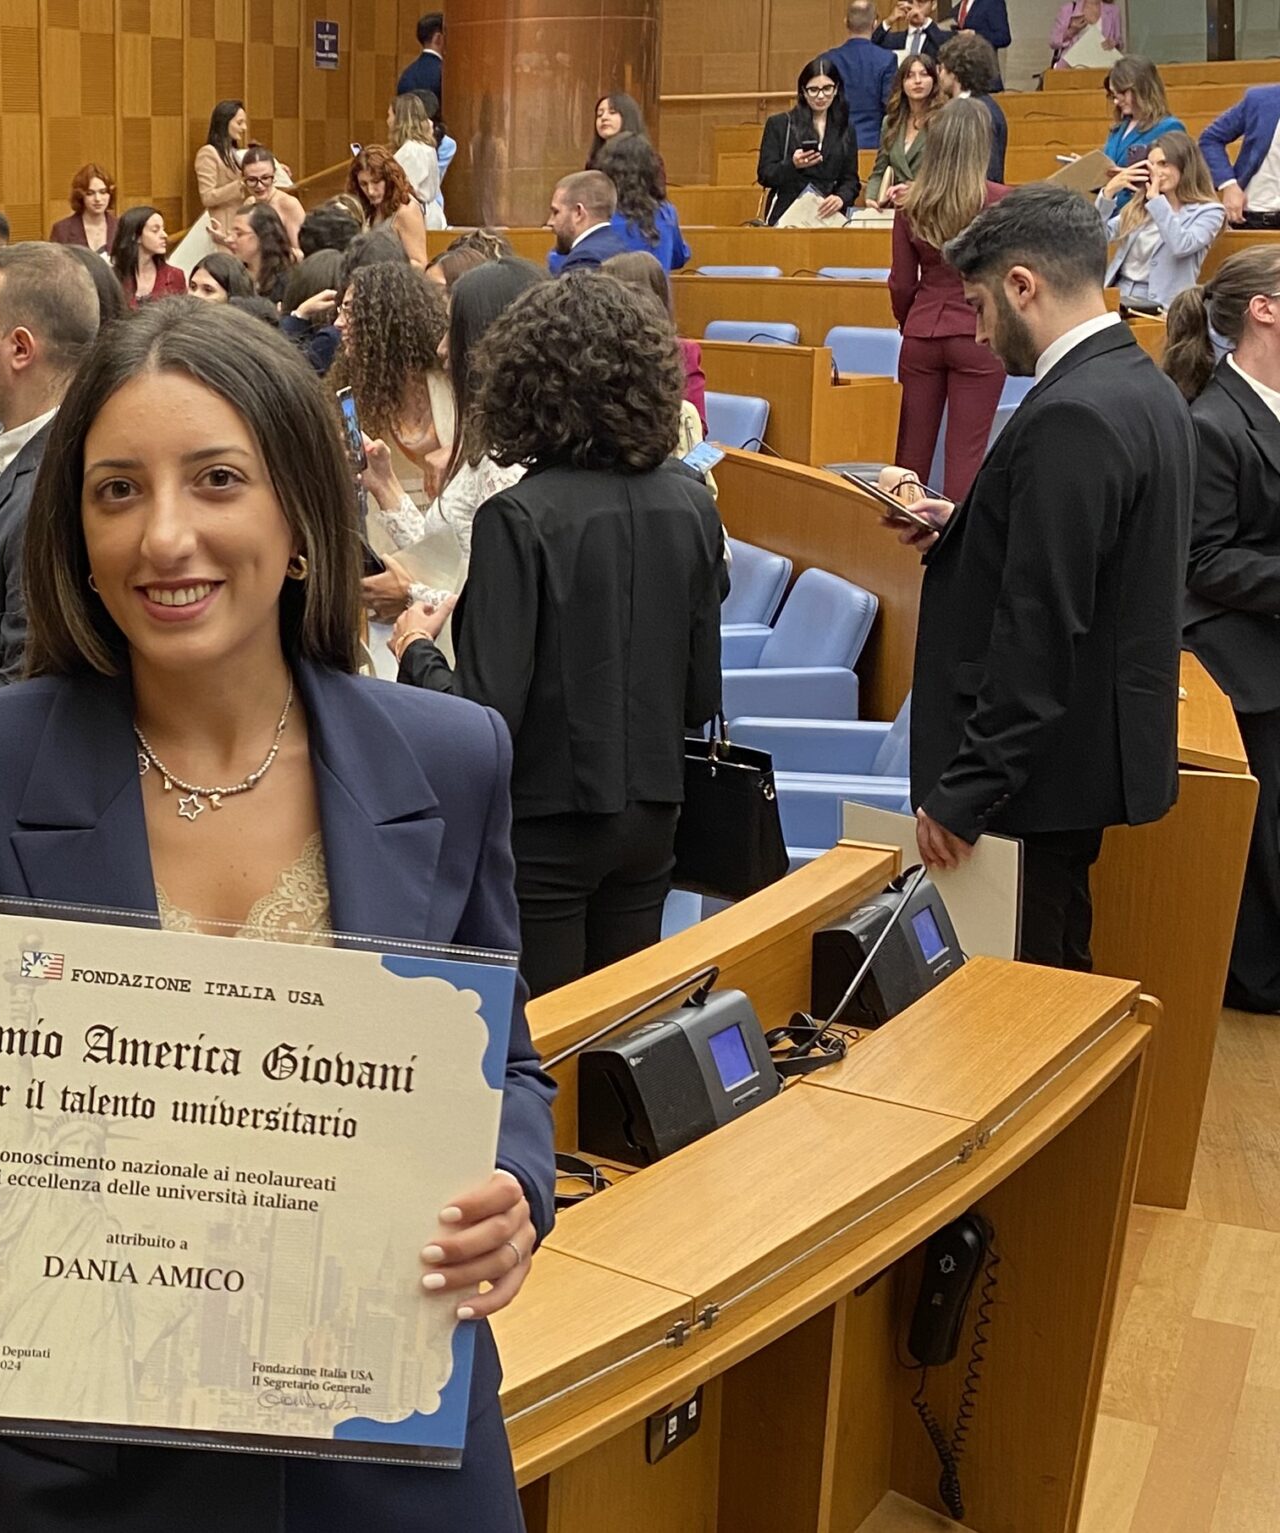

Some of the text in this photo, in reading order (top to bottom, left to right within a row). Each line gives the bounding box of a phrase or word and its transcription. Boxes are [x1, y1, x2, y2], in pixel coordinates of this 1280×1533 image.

[71, 968, 325, 1007] FONDAZIONE ITALIA USA
[83, 1024, 241, 1076] America
[262, 1043, 417, 1093] Giovani
[25, 1079, 46, 1111] il
[60, 1085, 155, 1119] talento
[172, 1095, 358, 1139] universitario
[7, 1173, 101, 1193] eccellenza
[107, 1178, 151, 1197] delle
[156, 1184, 247, 1206] università
[253, 1191, 320, 1212] italiane
[121, 1159, 208, 1181] nazionale
[214, 1166, 230, 1182] ai
[235, 1169, 337, 1193] neolaureati
[106, 1232, 188, 1251] attribuito a
[43, 1256, 244, 1292] DANIA AMICO
[1, 1346, 51, 1361] Deputati
[252, 1361, 374, 1381] Fondazione Italia USA
[252, 1375, 372, 1395] Il Segretario Generale
